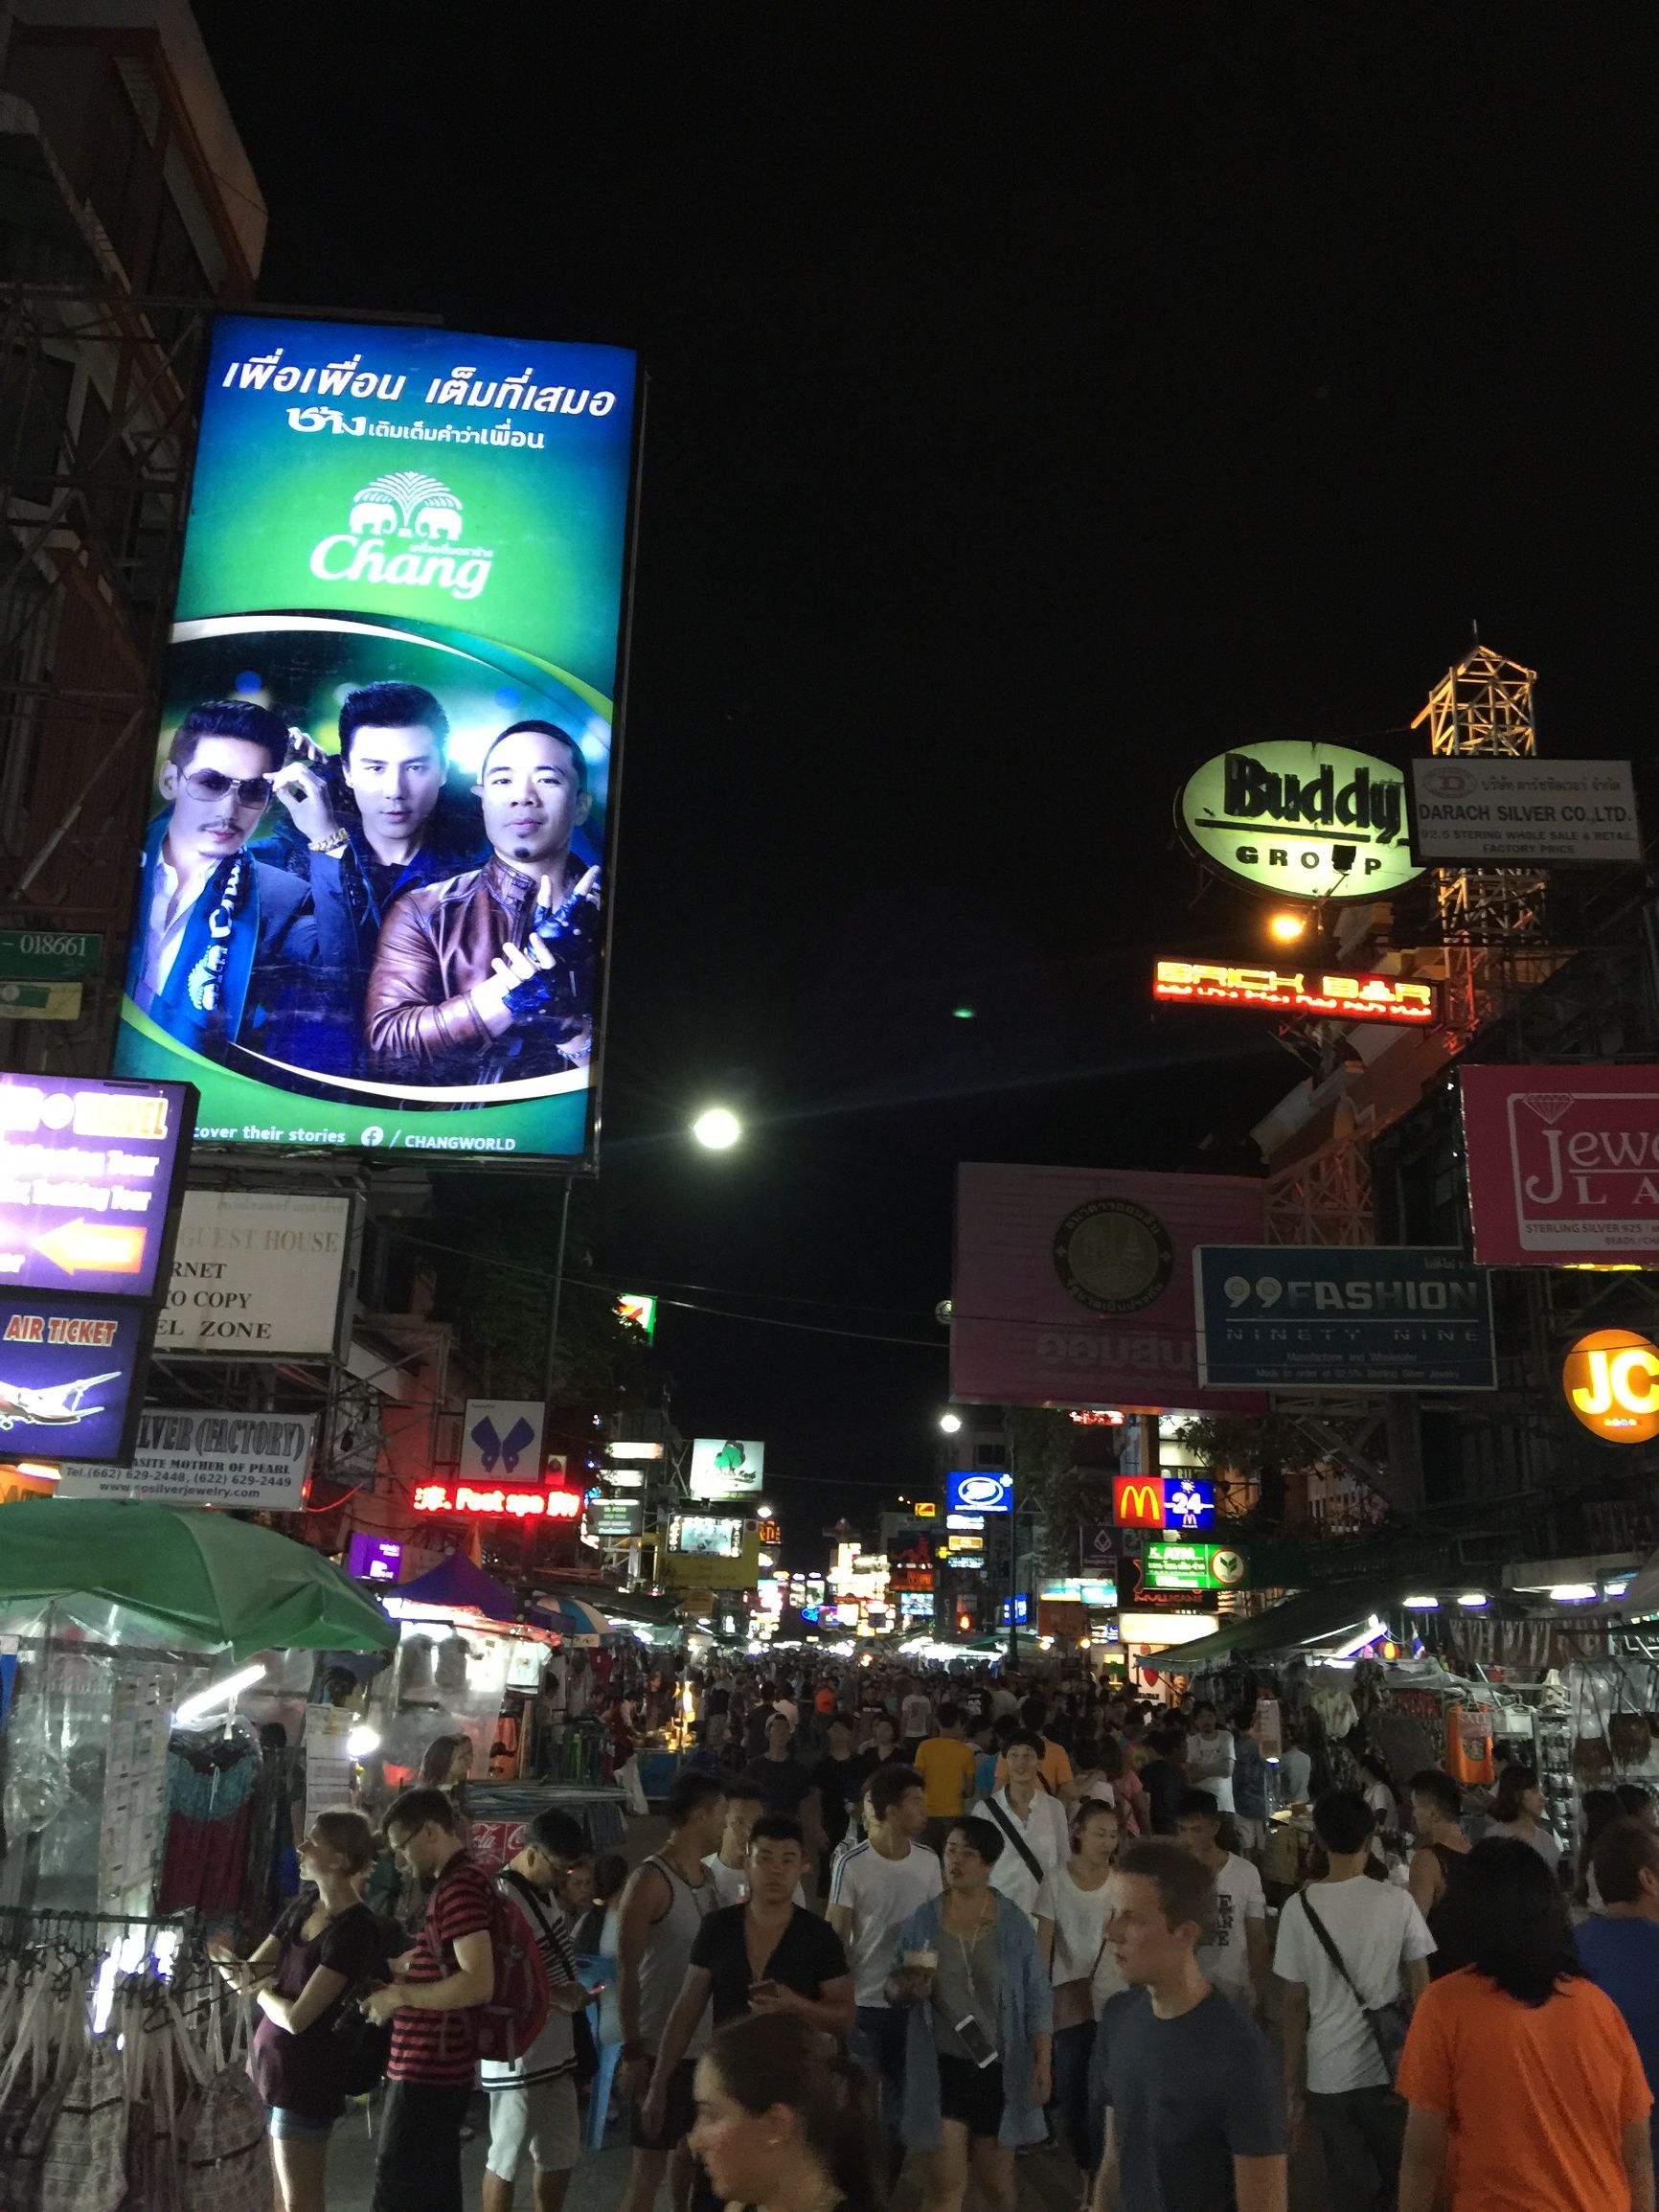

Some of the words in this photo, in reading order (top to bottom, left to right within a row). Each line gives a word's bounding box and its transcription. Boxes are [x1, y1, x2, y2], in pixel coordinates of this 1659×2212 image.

[222, 348, 406, 400] เพื่อเพื่อน
[425, 366, 616, 417] เต็มที่เสมอ
[309, 534, 492, 600] Chang
[1224, 752, 1401, 844] Buddy
[1419, 804, 1490, 821] DARACH
[1497, 806, 1556, 822] SILVER
[1506, 831, 1546, 841] WHOLE
[1550, 832, 1579, 841] SALE
[1235, 845, 1382, 876] GROP
[1483, 844, 1535, 854] FACTORY
[1540, 844, 1575, 854] PRICE
[20, 934, 87, 957] 018661
[1157, 961, 1305, 994] BRICK
[242, 1126, 284, 1142] their
[288, 1128, 347, 1144] stories
[405, 1133, 516, 1152] CHANGWORLD
[1525, 1129, 1659, 1205] Jew
[1525, 1223, 1579, 1234] STERLING
[1582, 1223, 1621, 1234] SILVER
[263, 1229, 339, 1253] HOUSE
[193, 1290, 253, 1310] COPY
[1286, 1280, 1480, 1311] FASHION
[3, 1314, 45, 1342] AIR
[48, 1316, 119, 1347] TICKET
[199, 1320, 272, 1339] ZONE
[1226, 1328, 1362, 1342] NINETY
[1393, 1329, 1480, 1342] NINE
[195, 1417, 306, 1463] (FACTORY)
[170, 1459, 225, 1472] MOTHER
[229, 1462, 245, 1472] OF
[250, 1463, 291, 1475] PEARL
[231, 1474, 292, 1488] 629-2449
